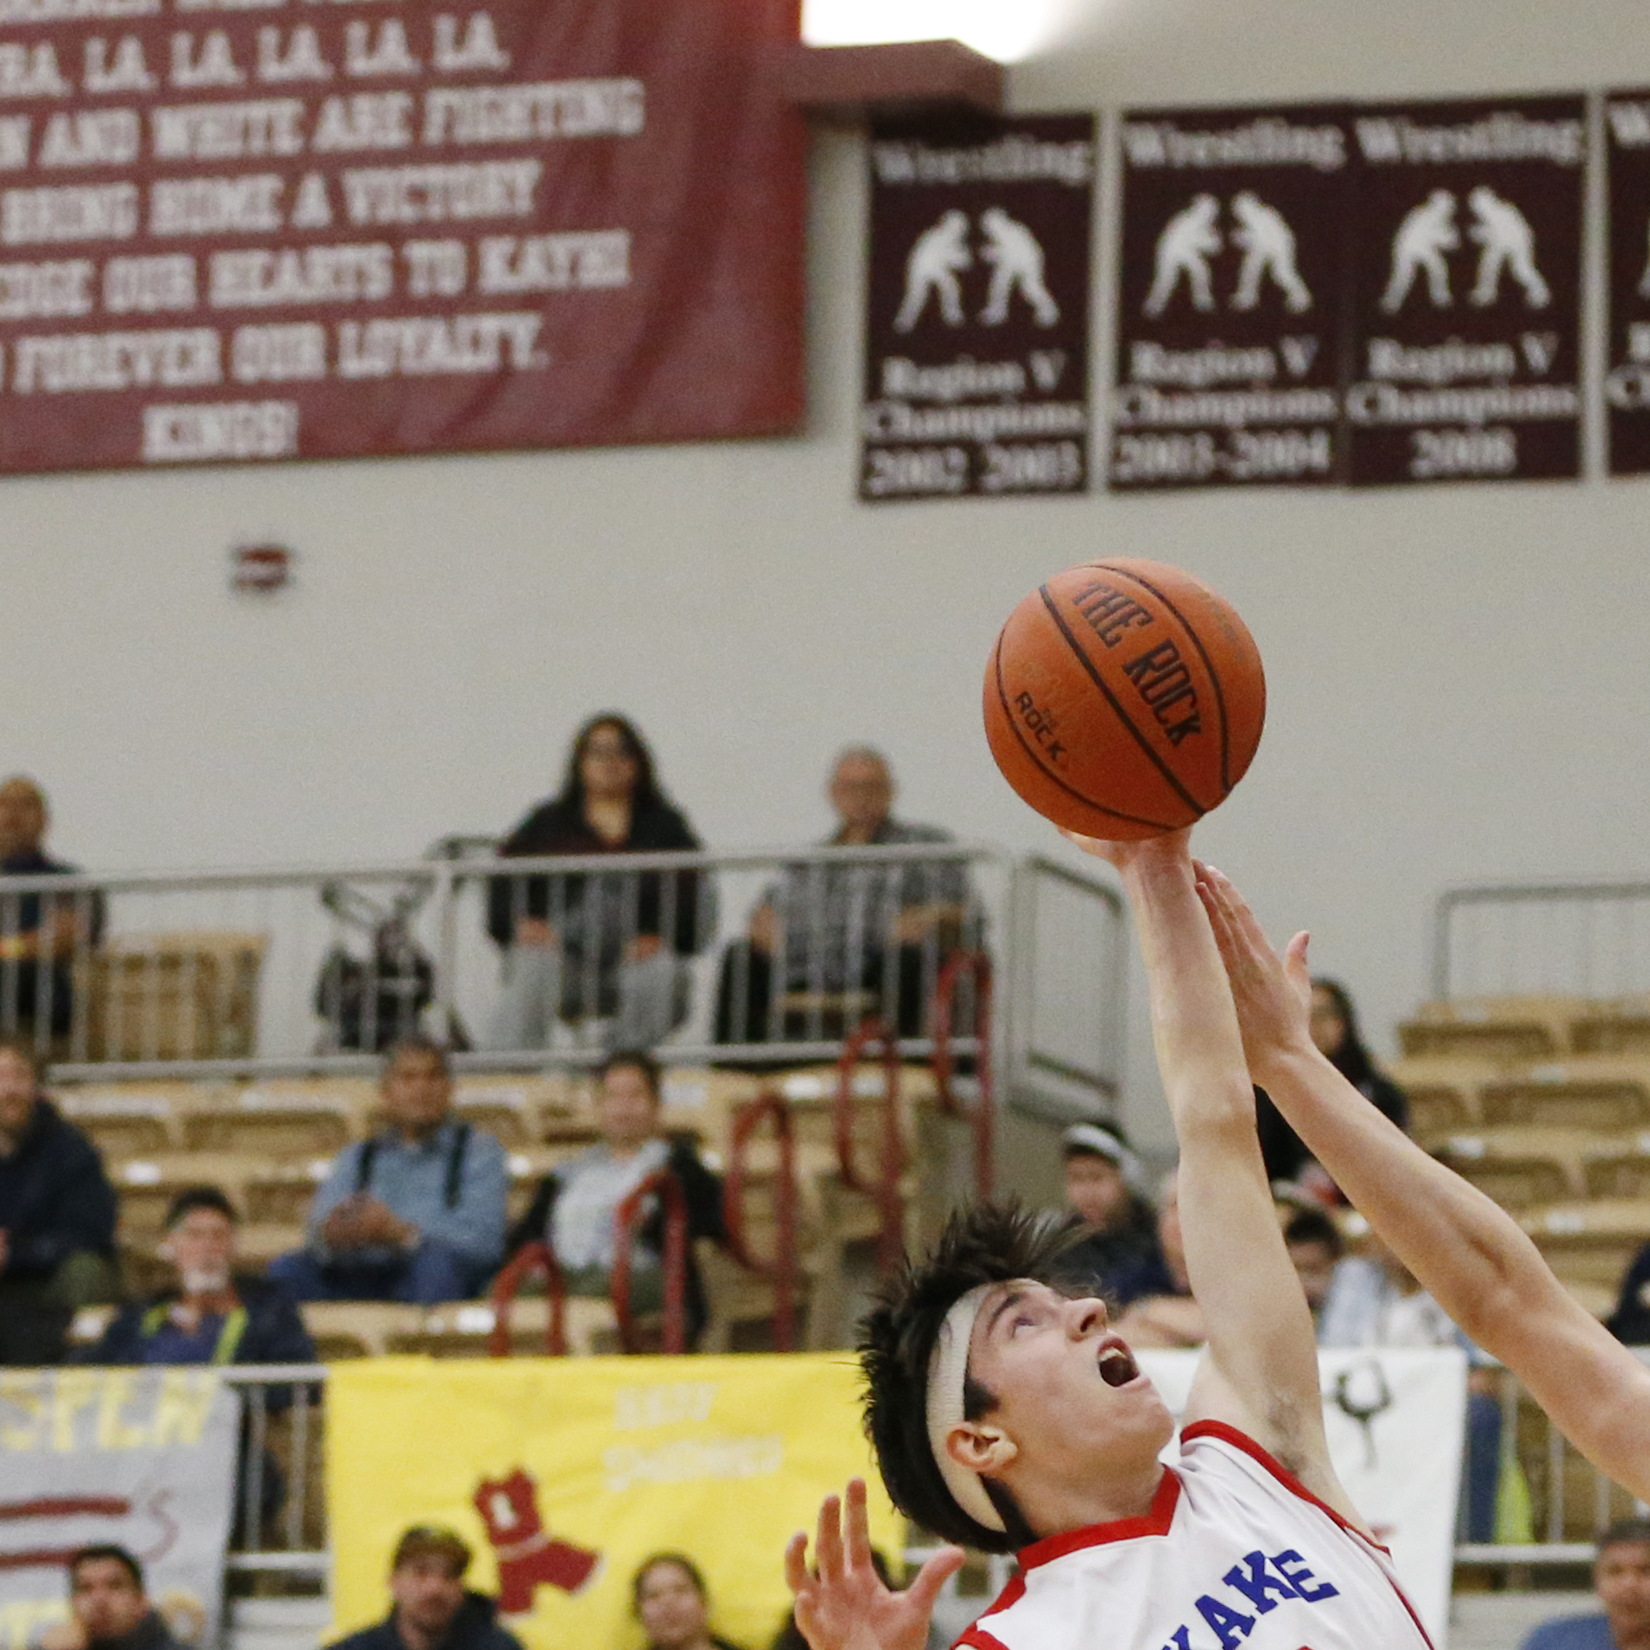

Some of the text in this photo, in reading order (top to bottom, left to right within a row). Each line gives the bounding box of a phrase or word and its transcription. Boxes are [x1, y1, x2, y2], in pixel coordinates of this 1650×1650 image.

[1122, 117, 1348, 172] Wrestling
[1353, 111, 1586, 166] Wrestling
[1073, 581, 1203, 747] THE ROCK
[1014, 691, 1067, 762] ROCK
